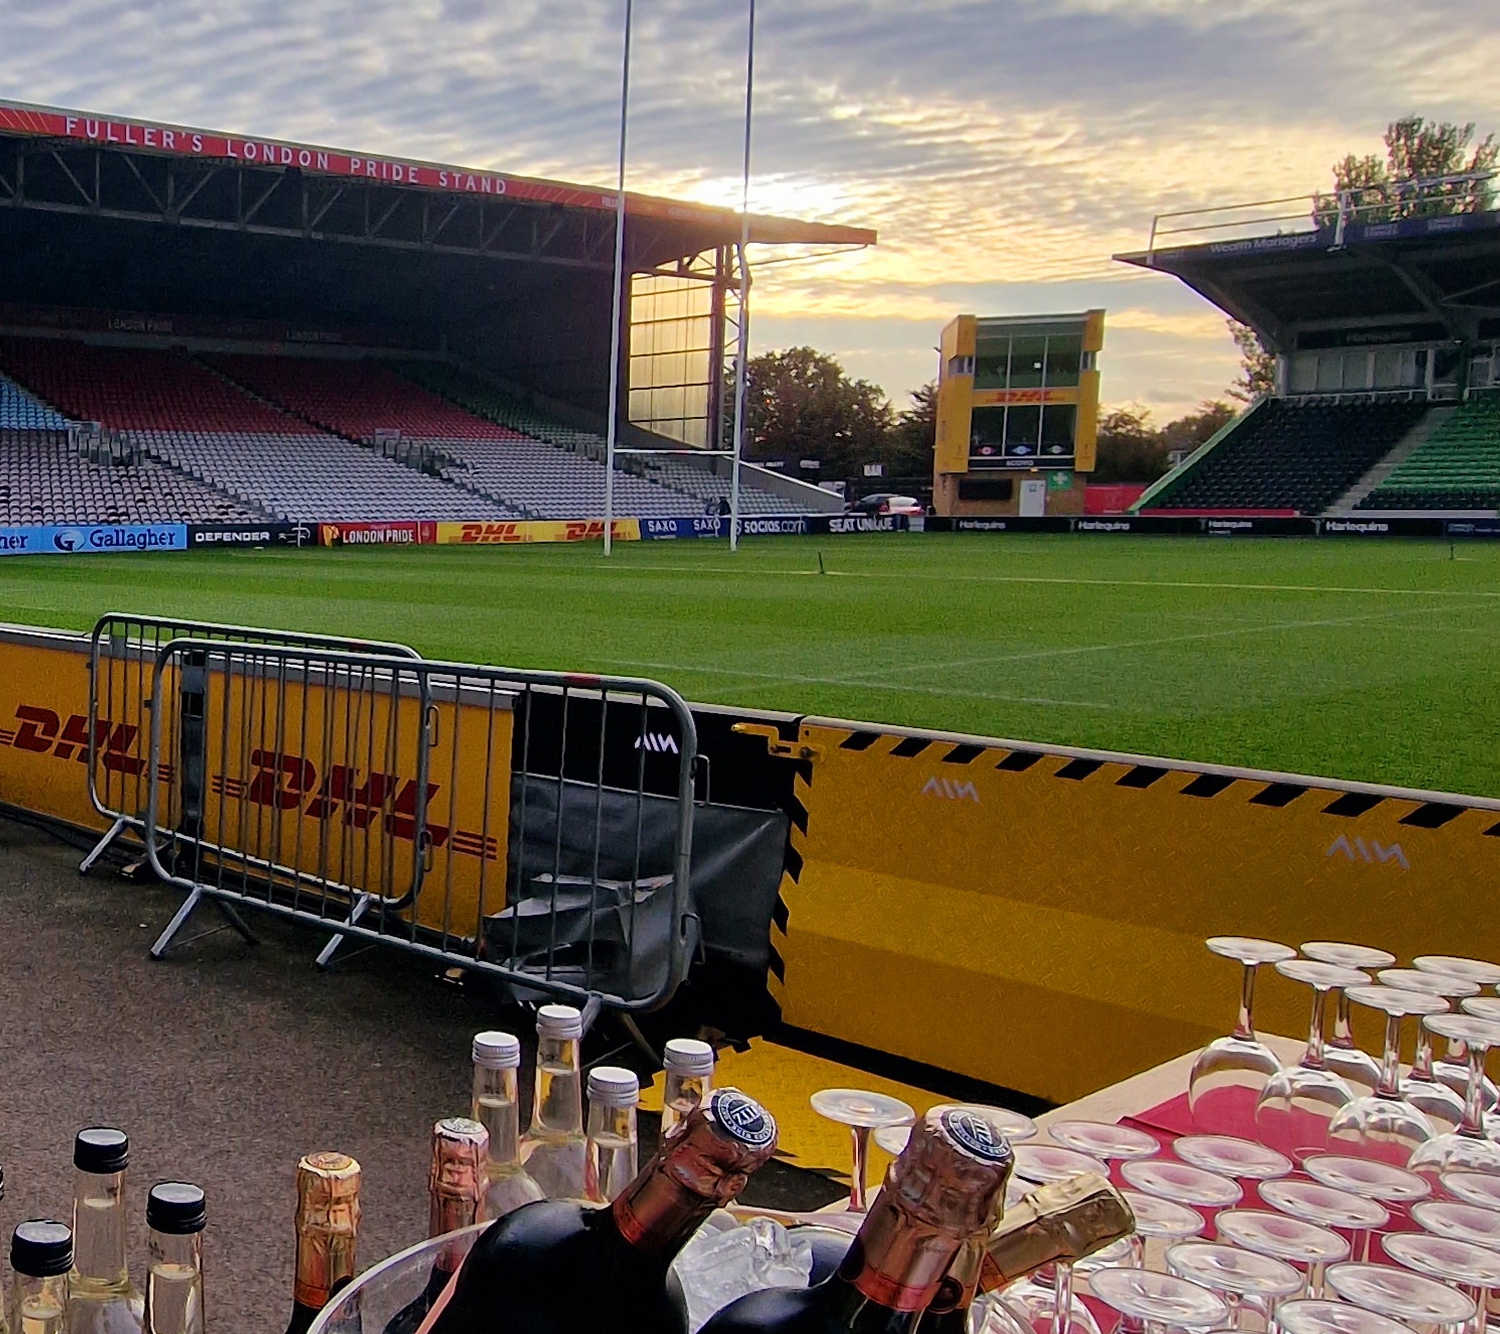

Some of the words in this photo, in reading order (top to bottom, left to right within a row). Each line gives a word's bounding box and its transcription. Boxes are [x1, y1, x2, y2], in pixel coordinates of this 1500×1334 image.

[64, 117, 203, 153] FULLER'S
[226, 138, 329, 171] LONDON
[350, 157, 419, 185] PRIDE
[438, 170, 508, 195] STAND
[996, 390, 1053, 402] DHL
[648, 520, 677, 532] SAXO
[693, 519, 721, 531] SAXO
[829, 518, 855, 533] SEAT
[959, 520, 1006, 530] Harlequins
[1078, 520, 1130, 531] Harlequins
[1208, 519, 1252, 529] Harlequins
[1325, 521, 1388, 533] Harlequins
[195, 531, 270, 542] DEFENDER
[342, 530, 384, 544] LONDON
[386, 528, 414, 543] PRIDE
[461, 524, 520, 542] DHL
[90, 529, 176, 550] Gallagher
[13, 704, 147, 775] DHL
[249, 748, 449, 847] DHL
